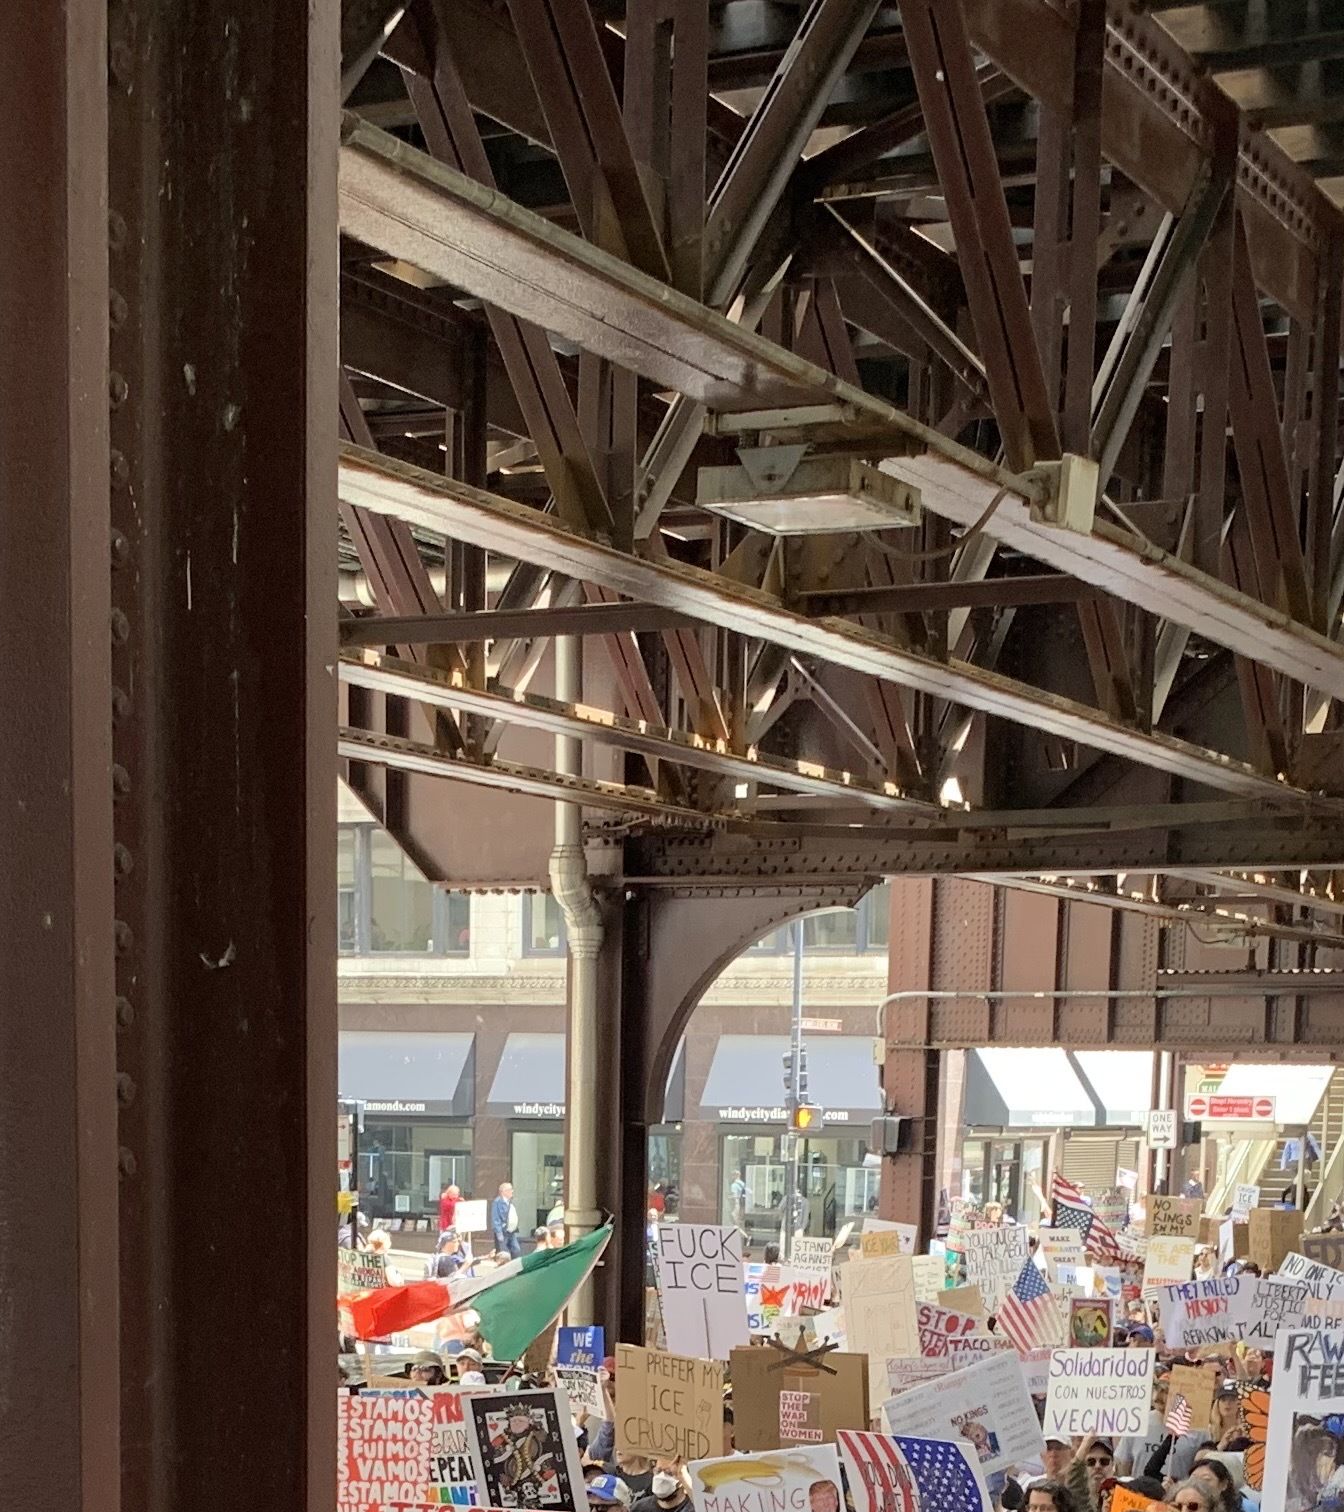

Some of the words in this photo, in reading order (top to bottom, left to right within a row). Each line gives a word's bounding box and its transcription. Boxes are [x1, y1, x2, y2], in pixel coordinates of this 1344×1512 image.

[1152, 1113, 1173, 1123] ONE
[1152, 1124, 1173, 1133] WAY
[1152, 1200, 1172, 1212] NO
[1239, 1192, 1252, 1204] ICE
[1153, 1212, 1193, 1227] KINGS
[1152, 1224, 1168, 1236] IN
[1168, 1224, 1186, 1236] MY
[659, 1227, 741, 1263] FUCK
[794, 1240, 832, 1253] STAND
[359, 1253, 383, 1269] THE
[793, 1254, 833, 1265] AGAINST
[1285, 1254, 1305, 1277] NO
[666, 1260, 740, 1293] ICE
[1166, 1283, 1201, 1302] THEY
[917, 1304, 976, 1337] STOP
[572, 1331, 593, 1348] WE
[948, 1338, 991, 1353] TACO
[569, 1349, 594, 1364] the
[1050, 1350, 1149, 1379] Solidaridad
[618, 1350, 635, 1371] I
[647, 1352, 695, 1387] PREFER
[701, 1364, 722, 1389] MY
[651, 1384, 685, 1416] ICE
[781, 1392, 809, 1403] STOP
[1055, 1384, 1080, 1400] CON
[1087, 1383, 1146, 1401] NUESTROS
[781, 1402, 803, 1412] THE
[781, 1411, 806, 1421] WAR
[950, 1415, 964, 1428] NO
[964, 1404, 989, 1422] KINGS
[1052, 1407, 1142, 1434] VECINOS
[781, 1420, 798, 1430] ON
[623, 1416, 711, 1461] CRUSHED
[781, 1428, 823, 1440] WOMEN
[355, 1440, 430, 1464] FUIMOS
[357, 1459, 430, 1483] VAMOS
